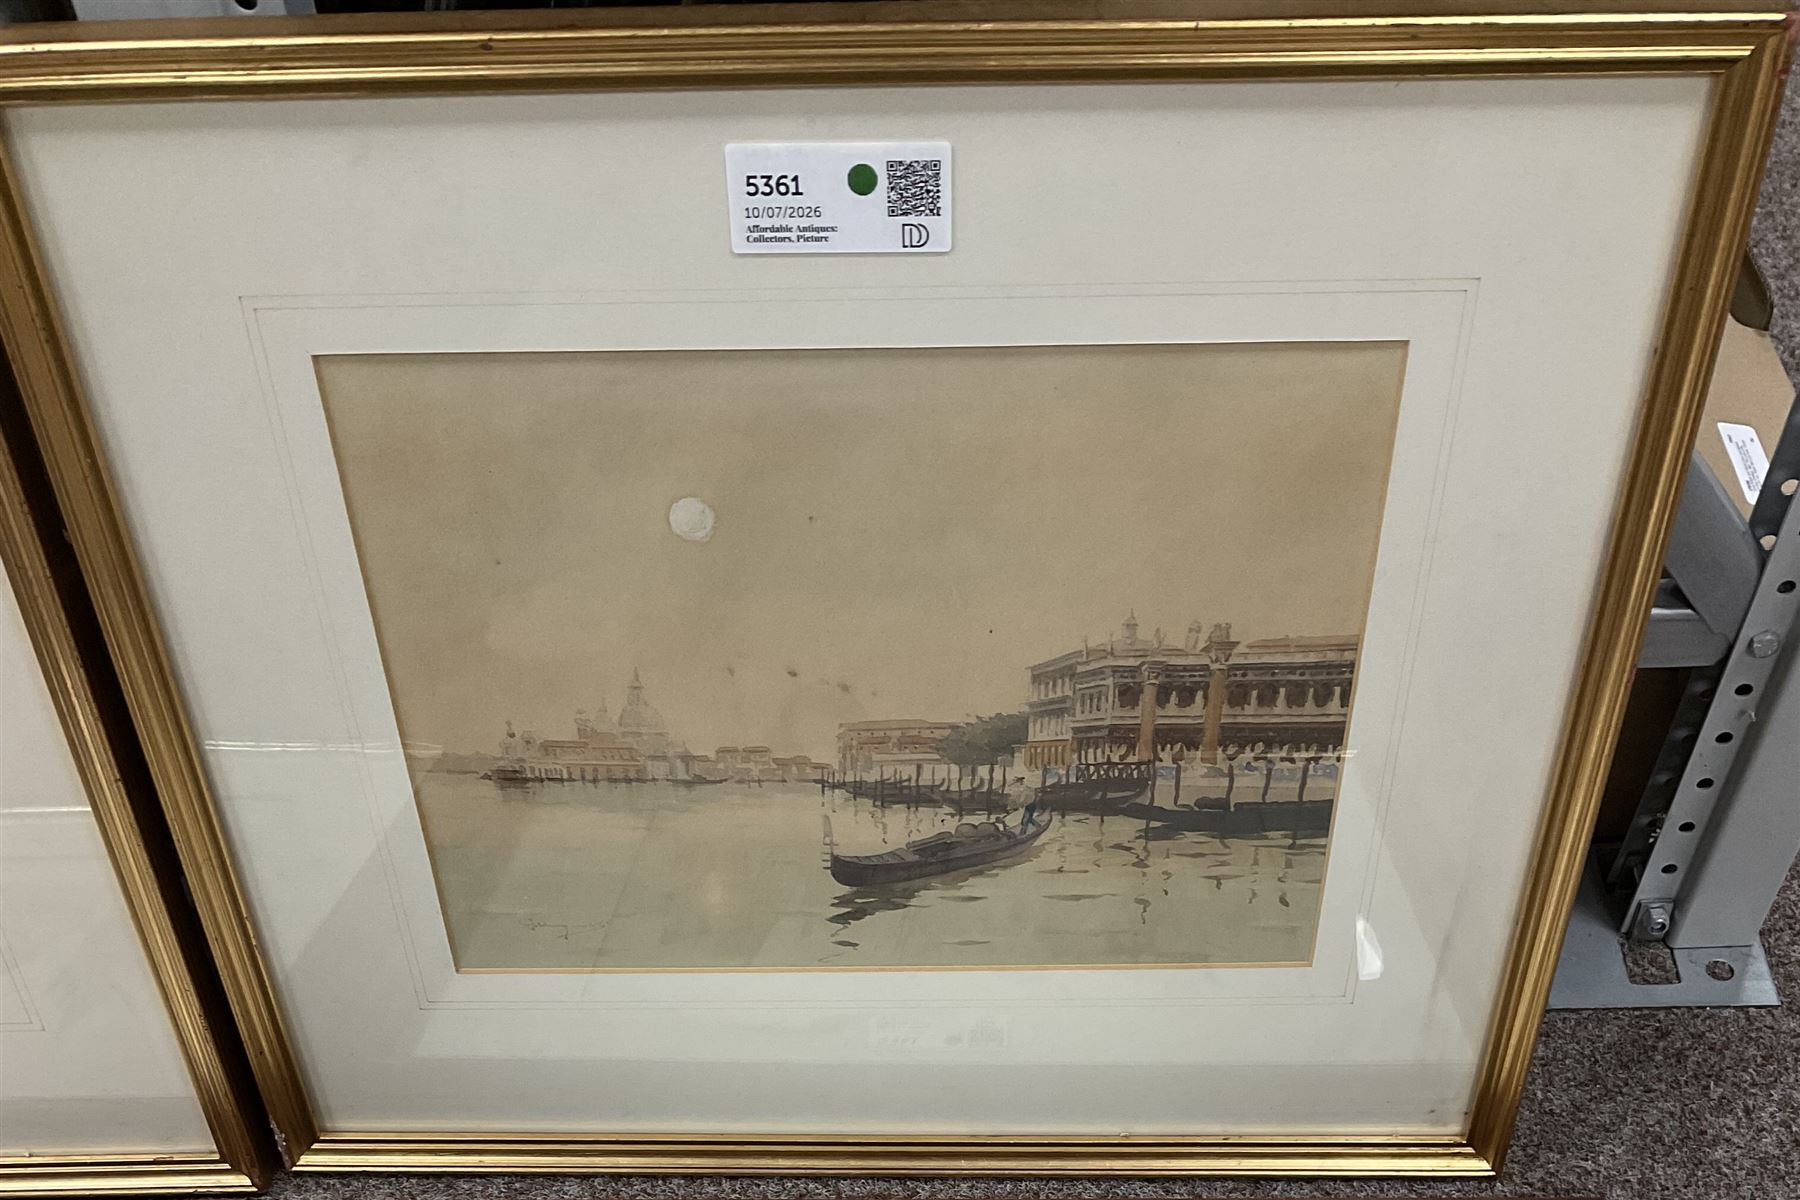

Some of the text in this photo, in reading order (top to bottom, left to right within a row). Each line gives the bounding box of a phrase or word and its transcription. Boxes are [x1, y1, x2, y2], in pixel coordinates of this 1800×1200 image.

[746, 175, 804, 197] 5361
[745, 206, 822, 219] 10/07/2026
[746, 224, 838, 235] Affordable Antiques:
[796, 234, 829, 243] Picture
